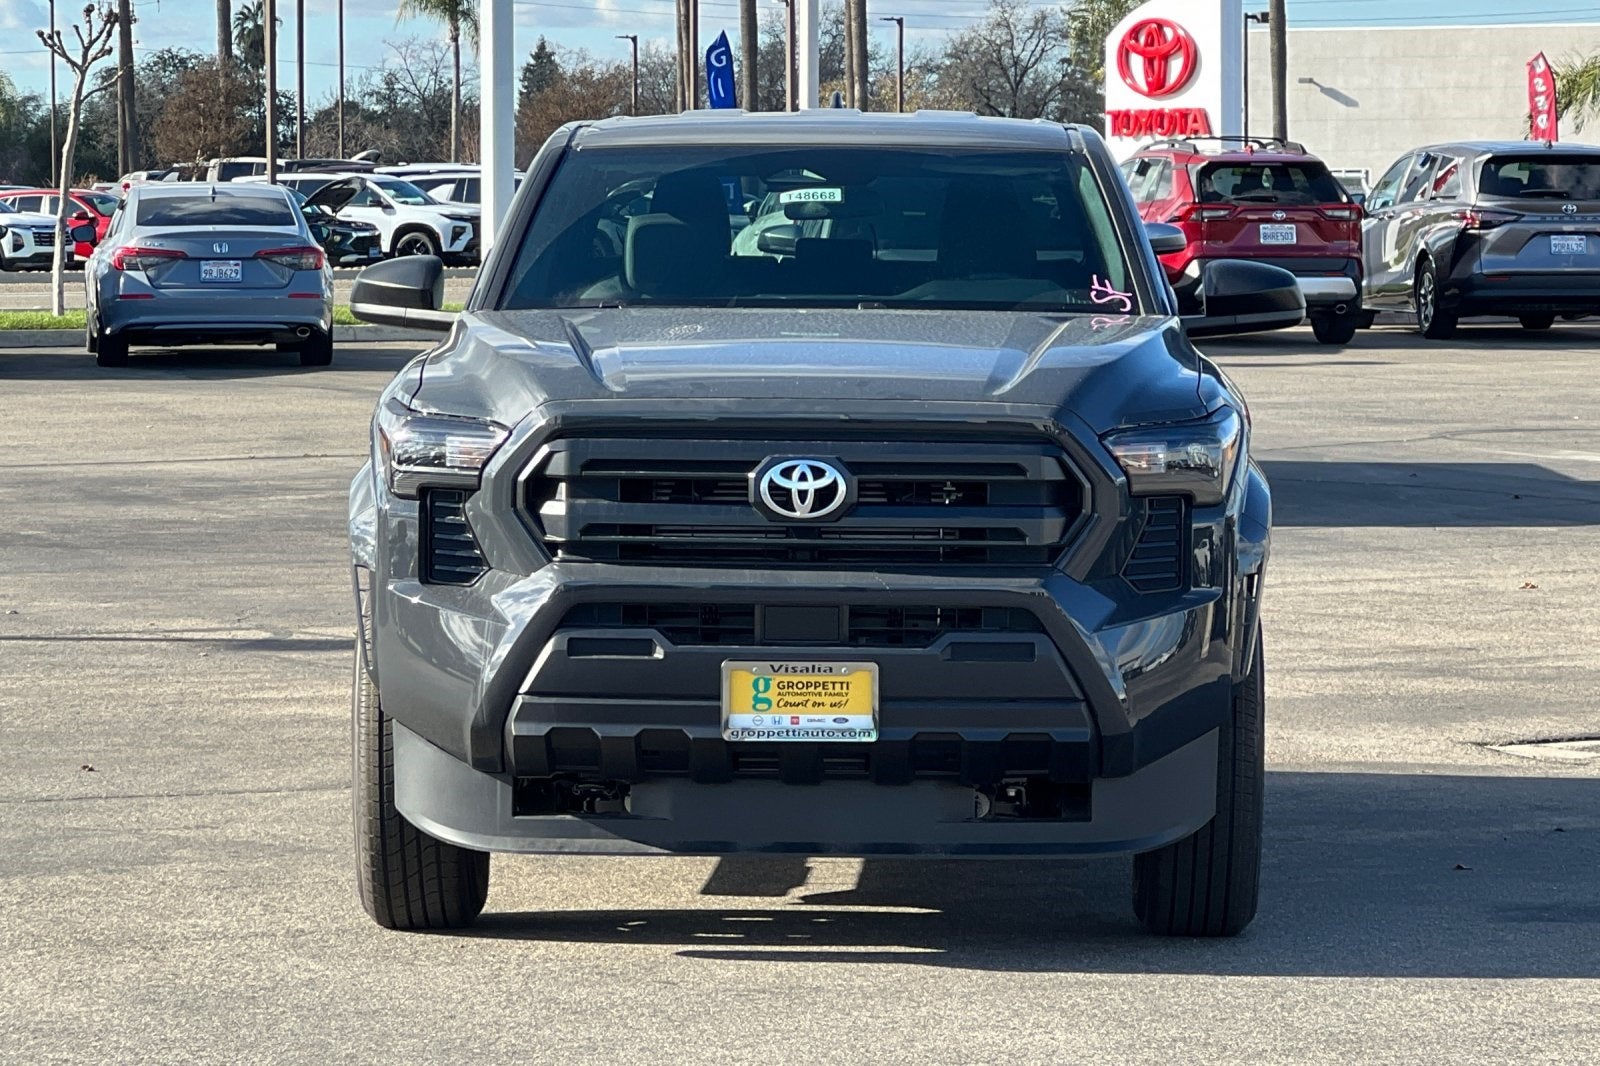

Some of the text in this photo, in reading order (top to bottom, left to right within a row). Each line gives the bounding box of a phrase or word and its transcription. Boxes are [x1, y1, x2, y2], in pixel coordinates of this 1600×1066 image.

[1107, 108, 1212, 137] TOYOTA
[786, 191, 836, 201] T48668
[203, 268, 239, 279] 9RJB629
[769, 664, 833, 673] Visalia
[776, 681, 850, 690] GROPPETTI
[776, 698, 810, 708] Count
[829, 698, 849, 708] us!
[730, 729, 871, 739] groppettiauto.com
